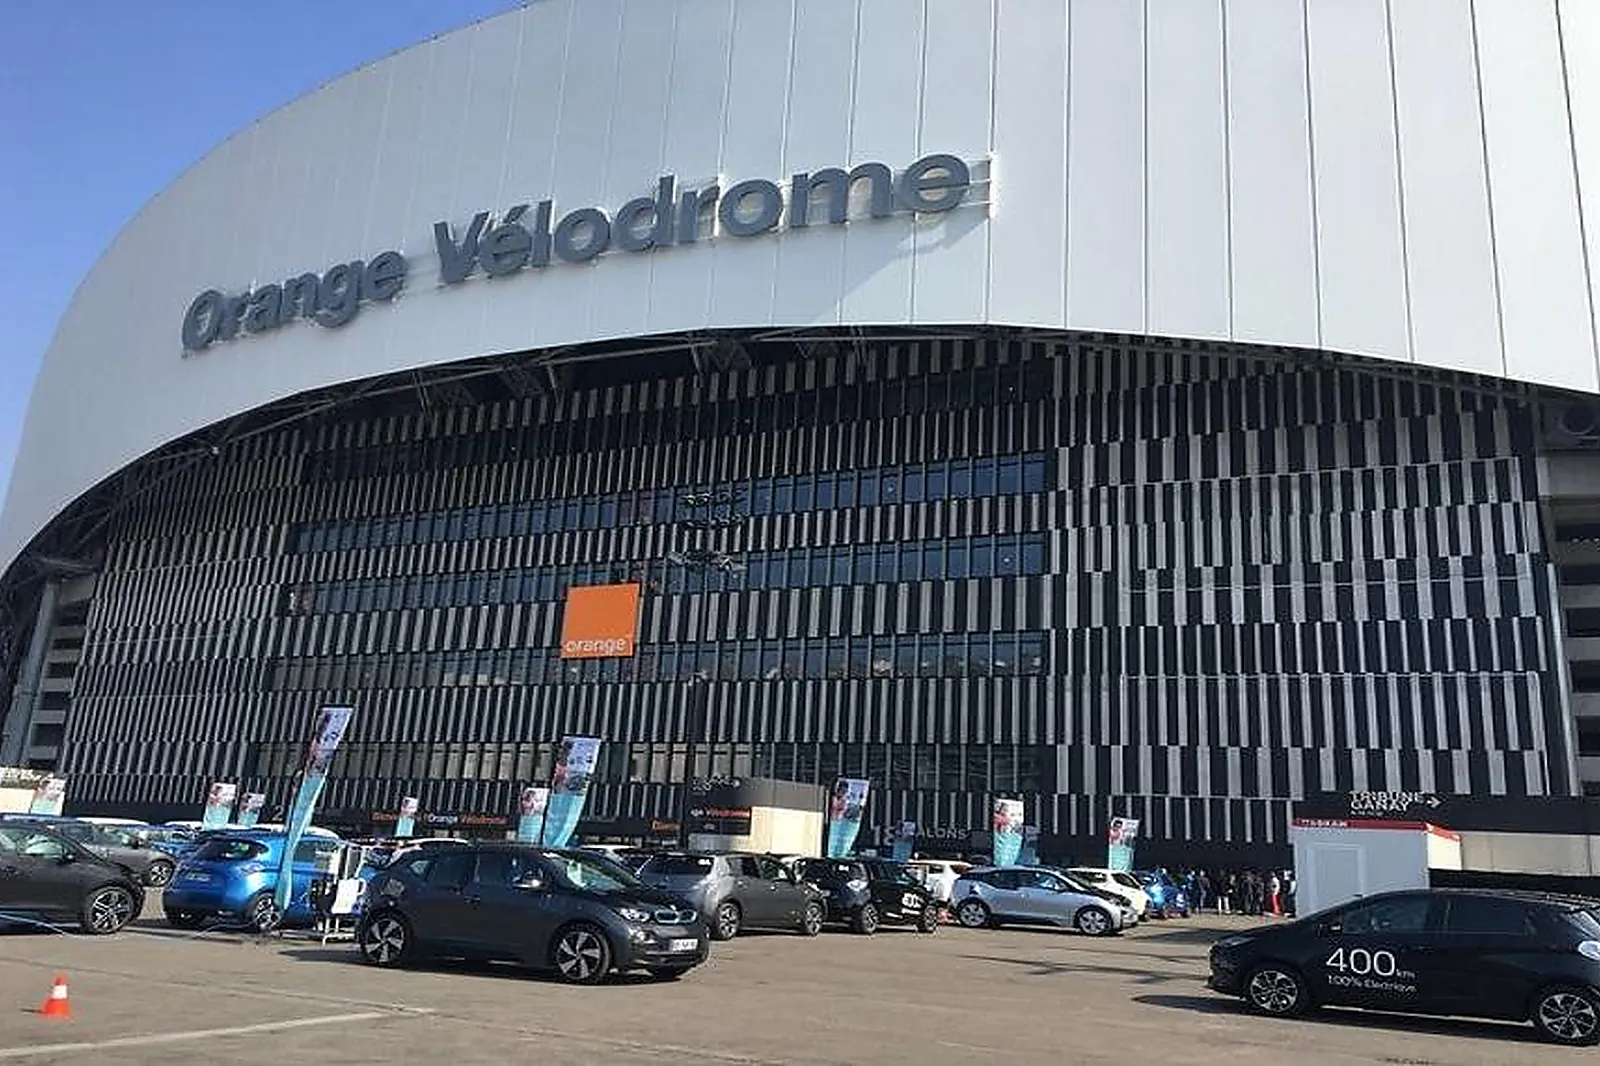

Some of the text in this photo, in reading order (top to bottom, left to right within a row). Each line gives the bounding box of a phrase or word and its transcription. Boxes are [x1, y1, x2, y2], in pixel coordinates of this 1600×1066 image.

[182, 150, 970, 351] Orange Vélodrome
[564, 639, 627, 656] orange
[272, 805, 284, 822] 2
[1326, 947, 1396, 976] 400
